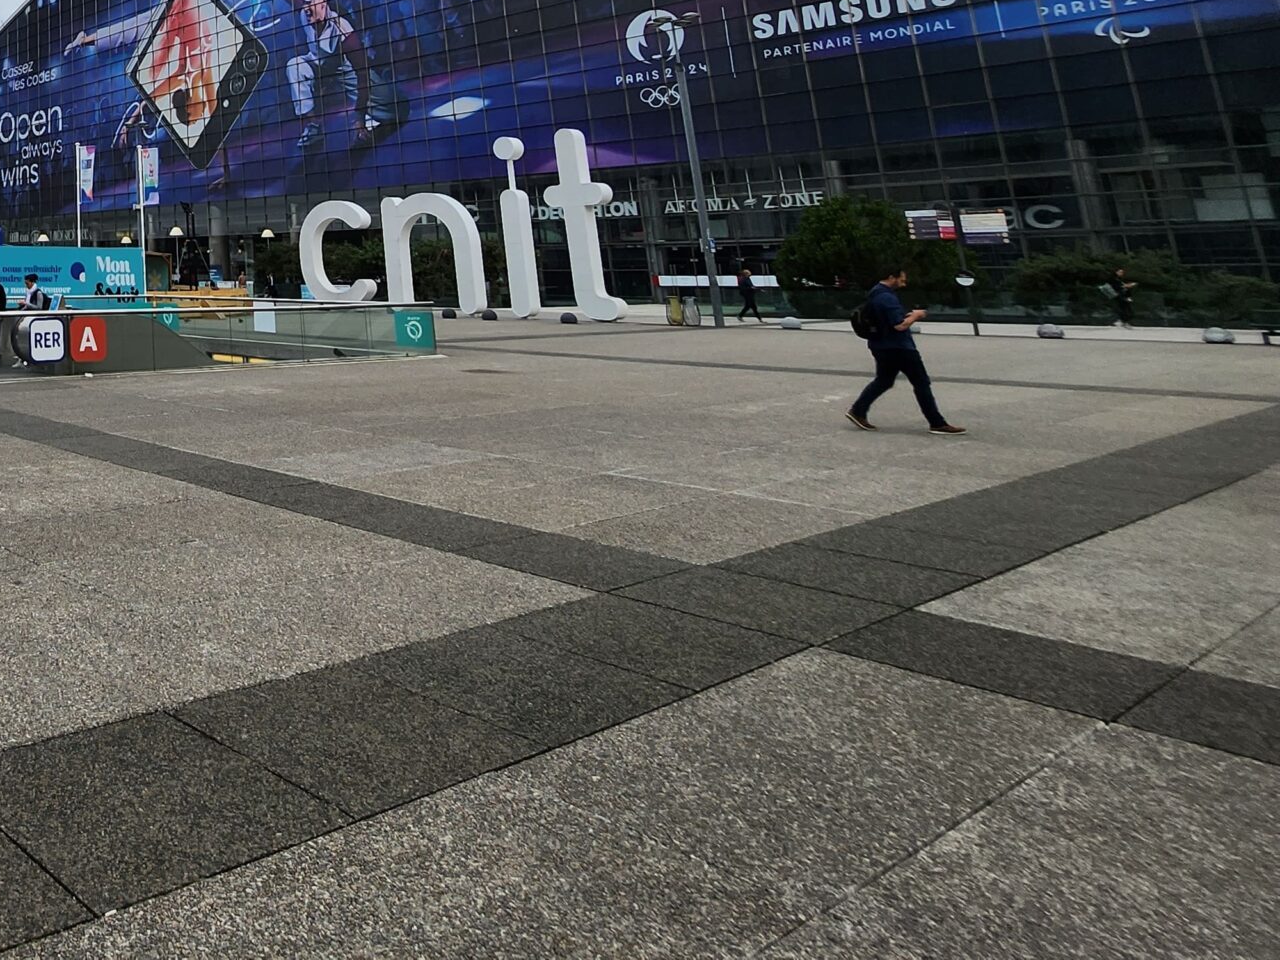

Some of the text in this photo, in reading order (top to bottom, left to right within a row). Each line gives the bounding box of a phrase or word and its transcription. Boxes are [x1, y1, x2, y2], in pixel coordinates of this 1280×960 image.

[763, 19, 955, 59] PARTENAIRE MONDIAL
[1, 60, 34, 80] Cassez
[12, 68, 57, 92] les codes
[665, 62, 708, 78] 224
[21, 139, 63, 160] always
[1, 160, 39, 187] wins
[299, 128, 628, 322] cnit
[96, 256, 131, 273] Mon
[105, 273, 136, 287] eau
[34, 326, 98, 352] RER A
